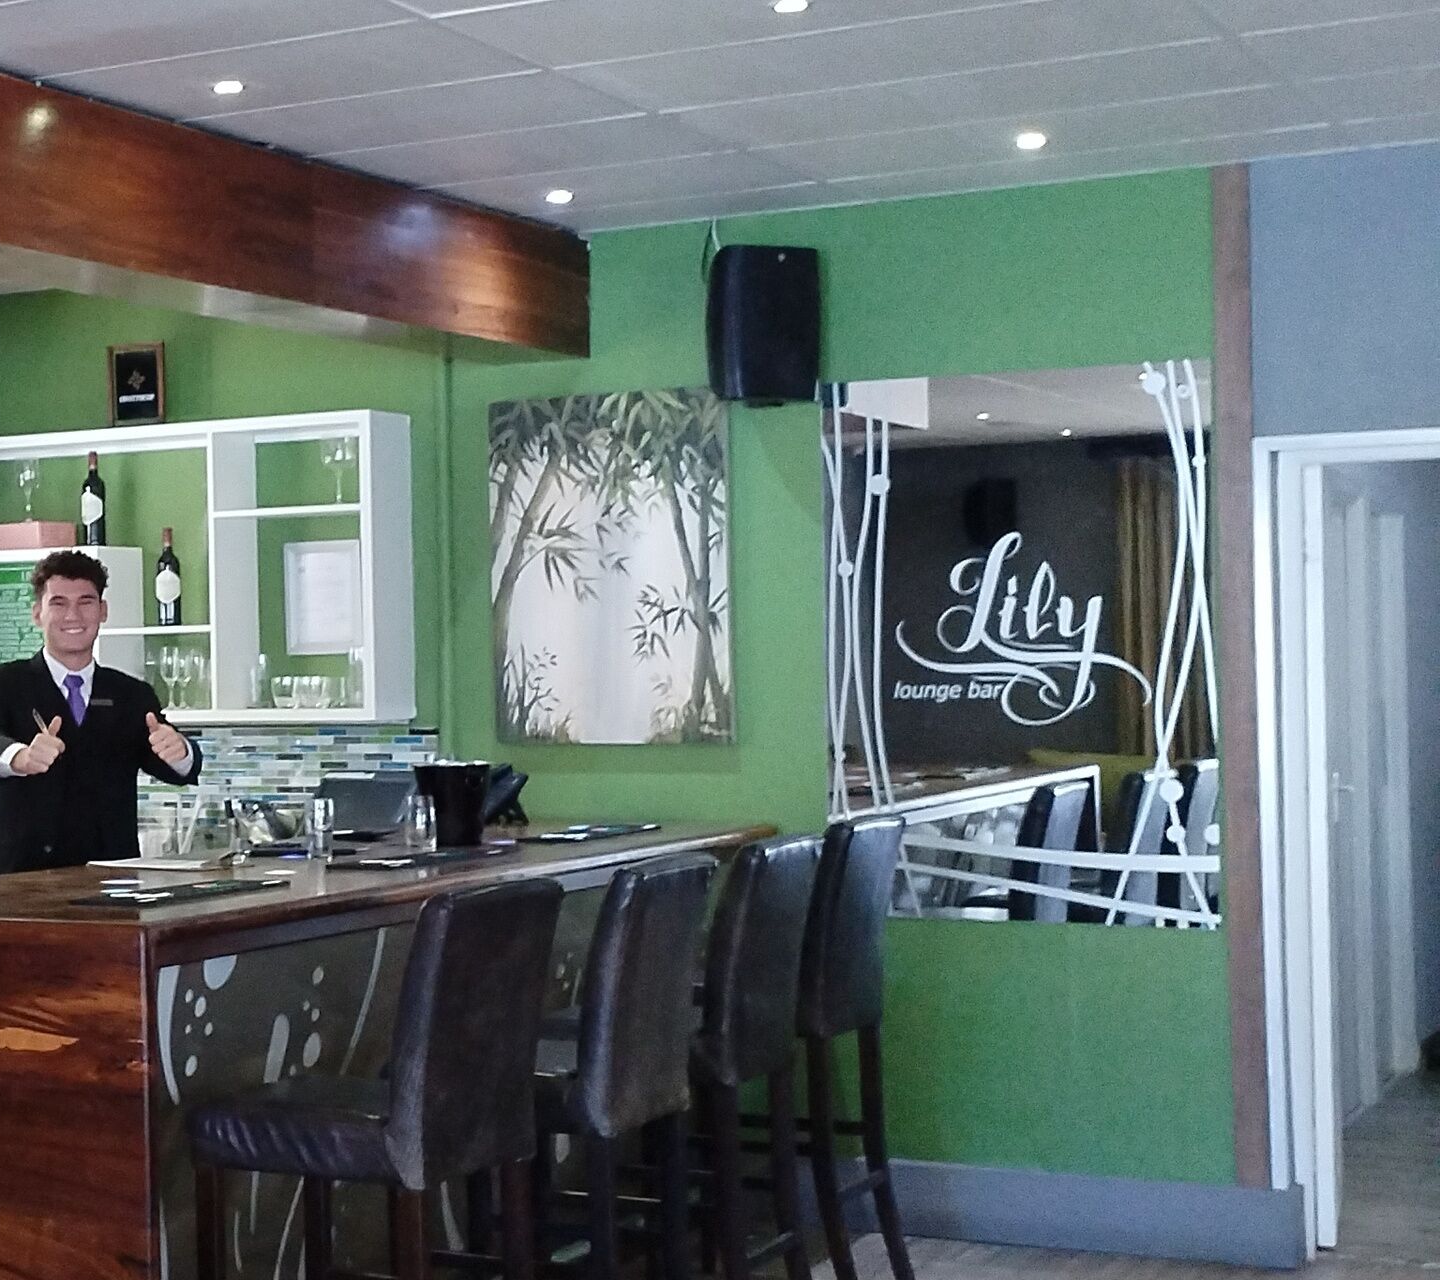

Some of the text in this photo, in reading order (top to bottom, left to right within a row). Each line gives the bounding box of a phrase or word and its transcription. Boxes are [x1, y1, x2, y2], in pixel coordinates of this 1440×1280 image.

[937, 531, 1152, 726] Lily
[893, 681, 1003, 702] lounge bar
